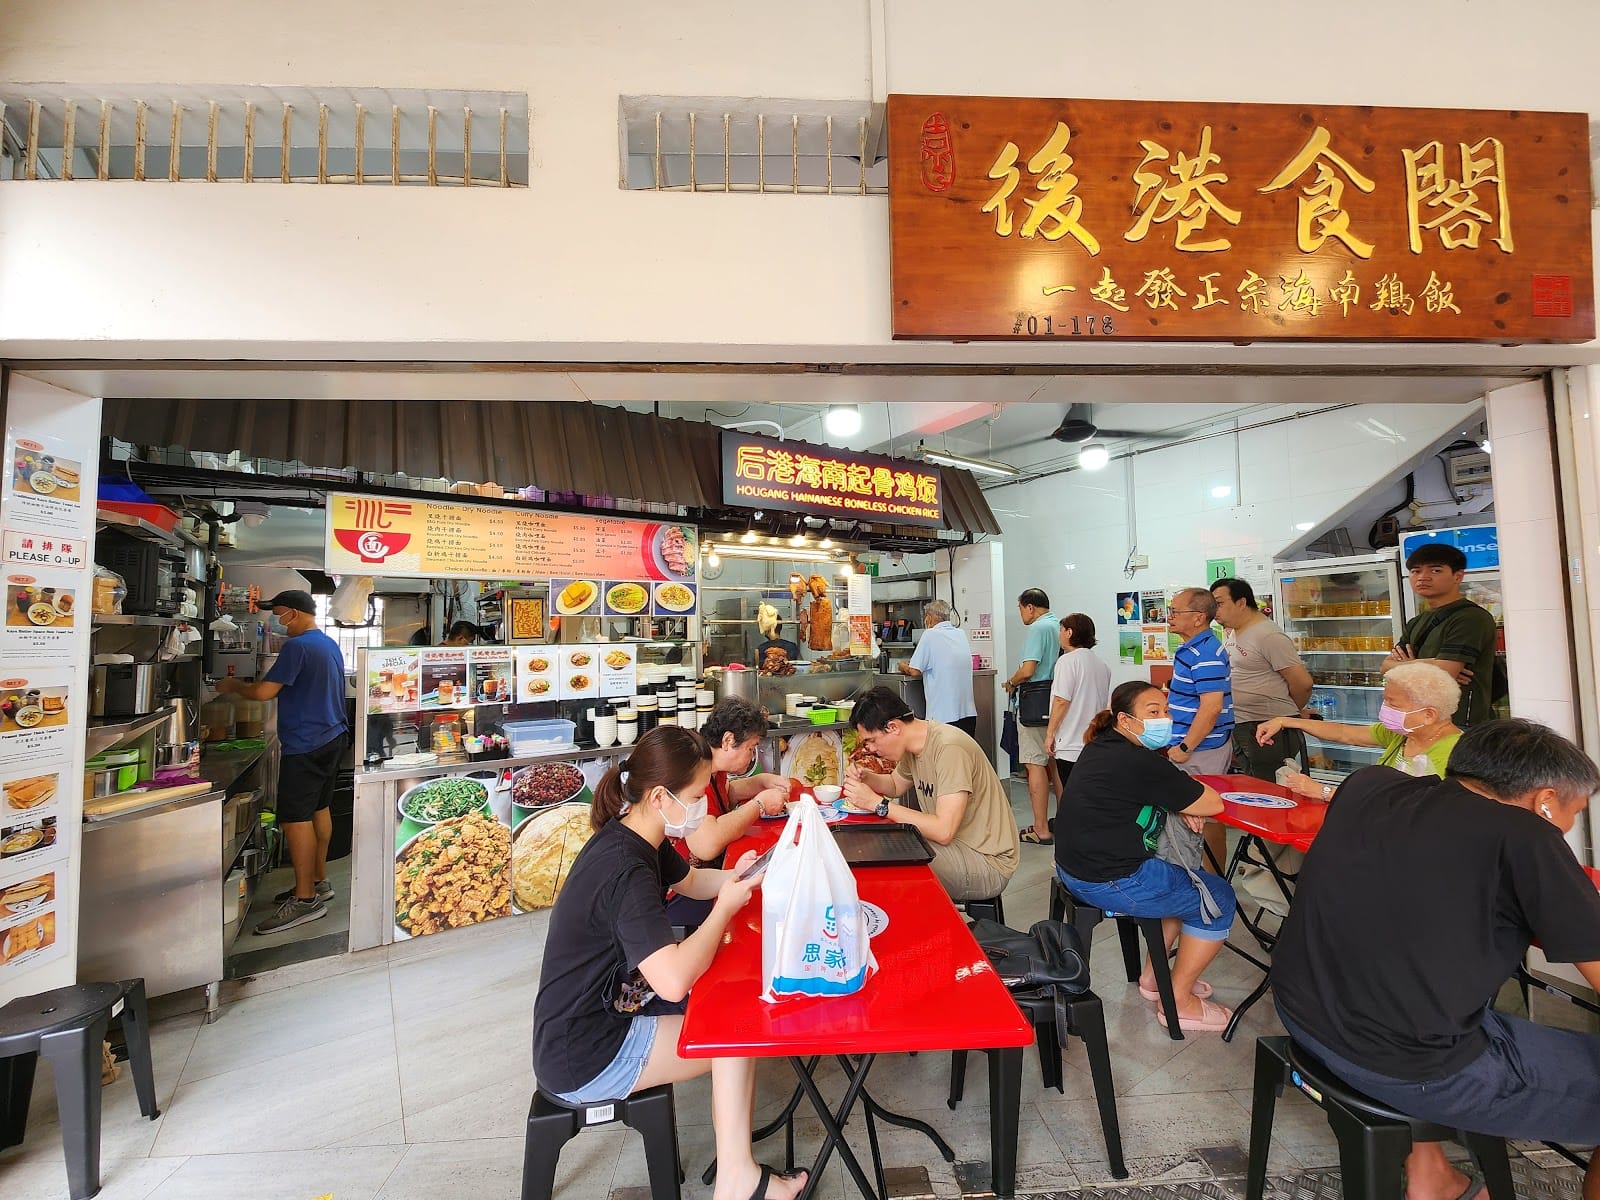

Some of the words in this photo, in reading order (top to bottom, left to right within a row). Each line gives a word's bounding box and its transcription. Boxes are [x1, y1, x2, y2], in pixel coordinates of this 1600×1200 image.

[980, 120, 1515, 259] 後港食閣
[736, 446, 939, 505] 后港海南起骨鸡饭
[736, 485, 788, 500] HOUGANG
[791, 491, 843, 508] HAINANESE
[845, 498, 888, 513] BONELESS
[888, 503, 922, 516] CHICKEN
[923, 507, 940, 519] RICE
[9, 550, 50, 563] PLEASE
[22, 538, 73, 553] 請排隊
[802, 943, 846, 969] 思家
